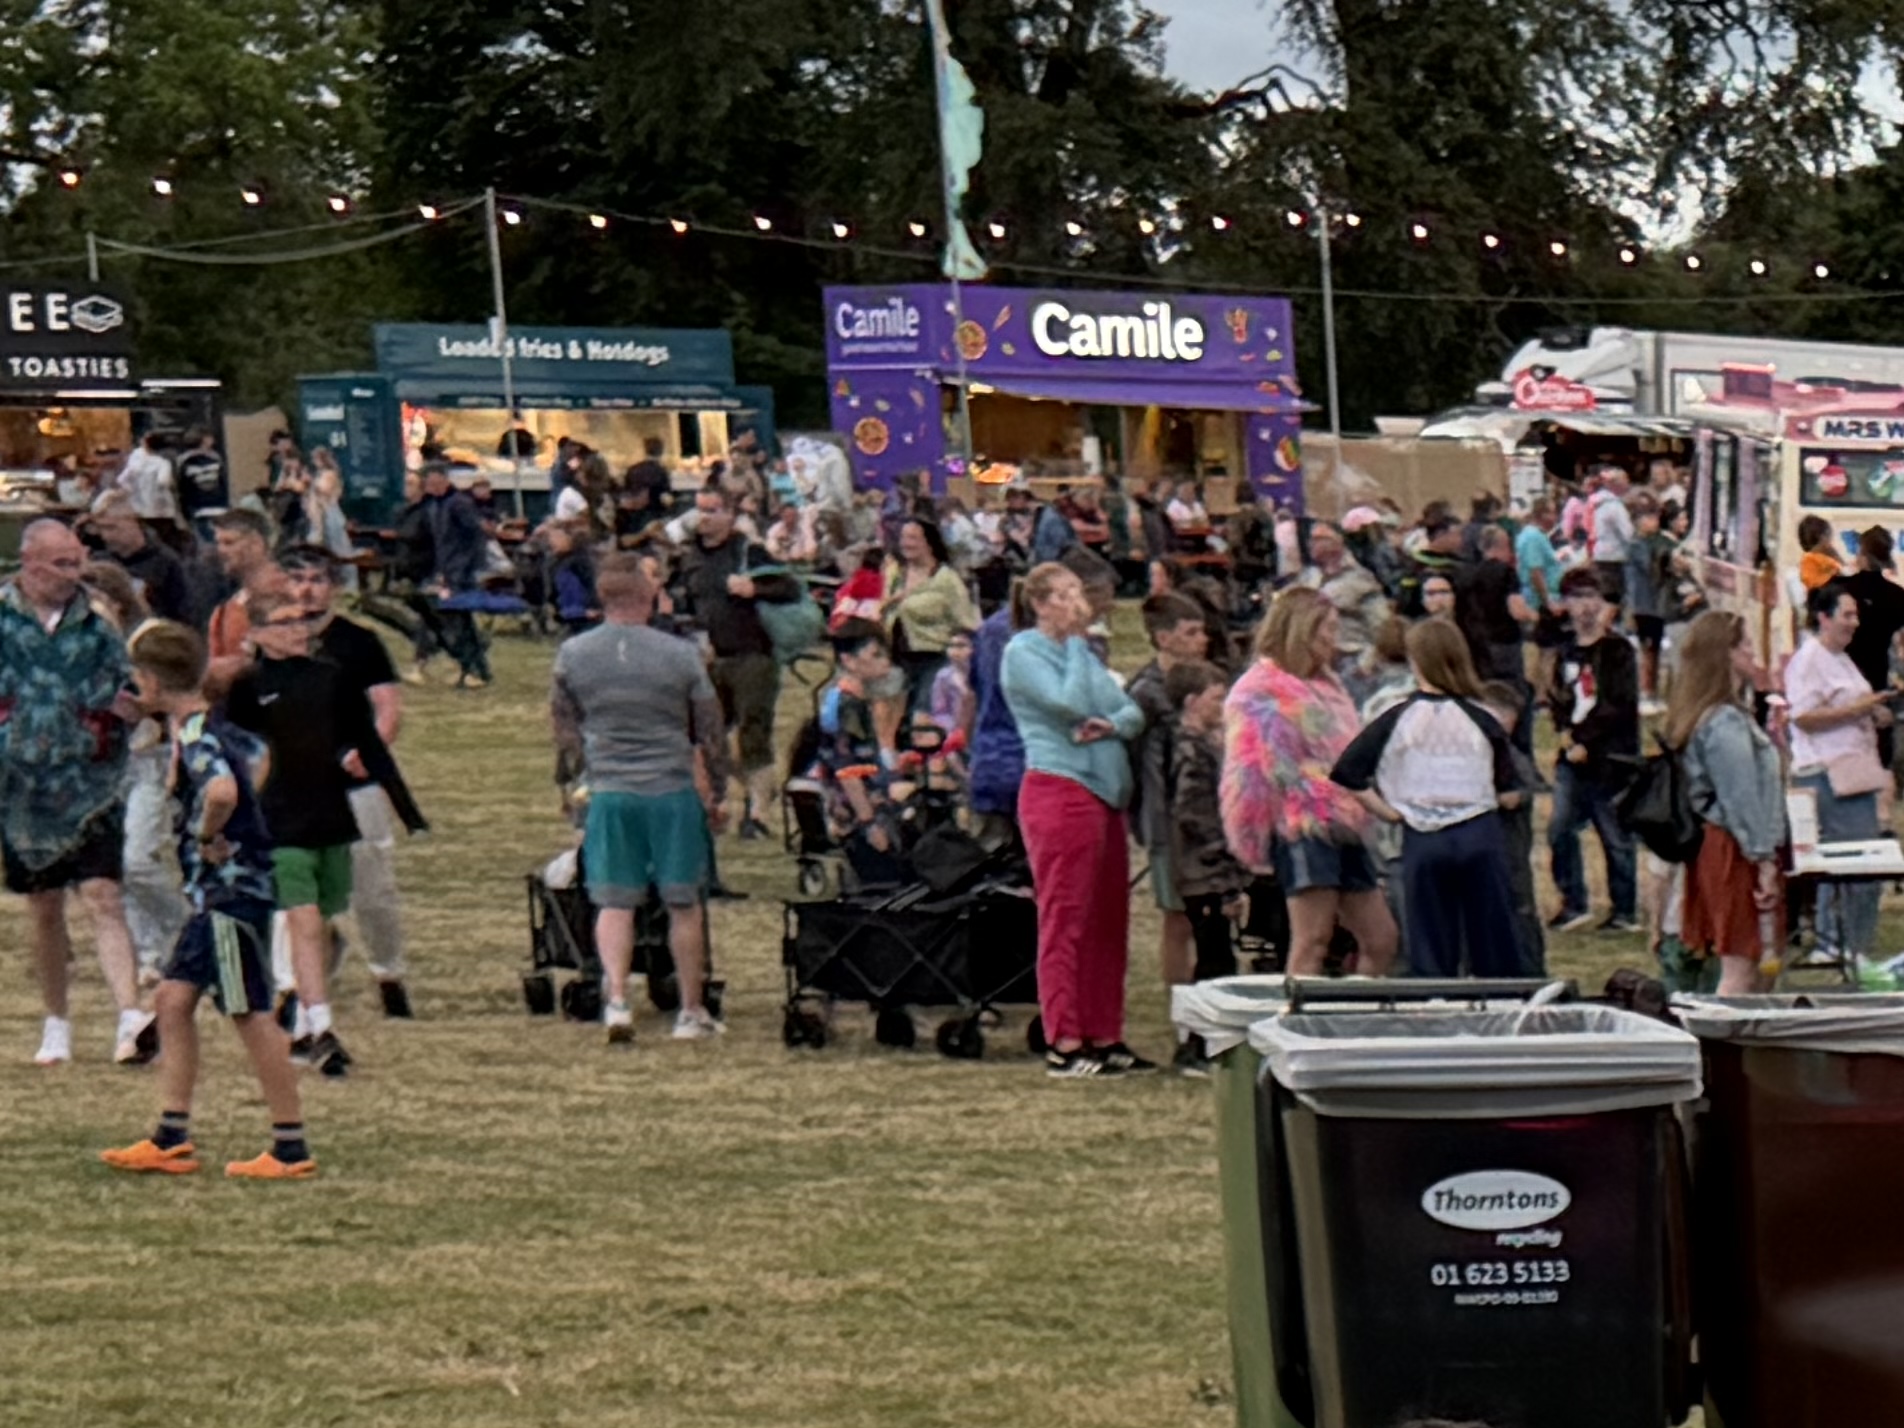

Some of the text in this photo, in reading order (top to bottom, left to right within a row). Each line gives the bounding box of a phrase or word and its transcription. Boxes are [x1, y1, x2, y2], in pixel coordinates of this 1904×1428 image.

[835, 297, 920, 339] Camile
[1032, 301, 1204, 361] Camile
[8, 356, 129, 379] TOASTIES
[1824, 420, 1881, 438] MRS
[1435, 1188, 1559, 1212] Thorntons
[1431, 1260, 1570, 1286] 01 623 5133
